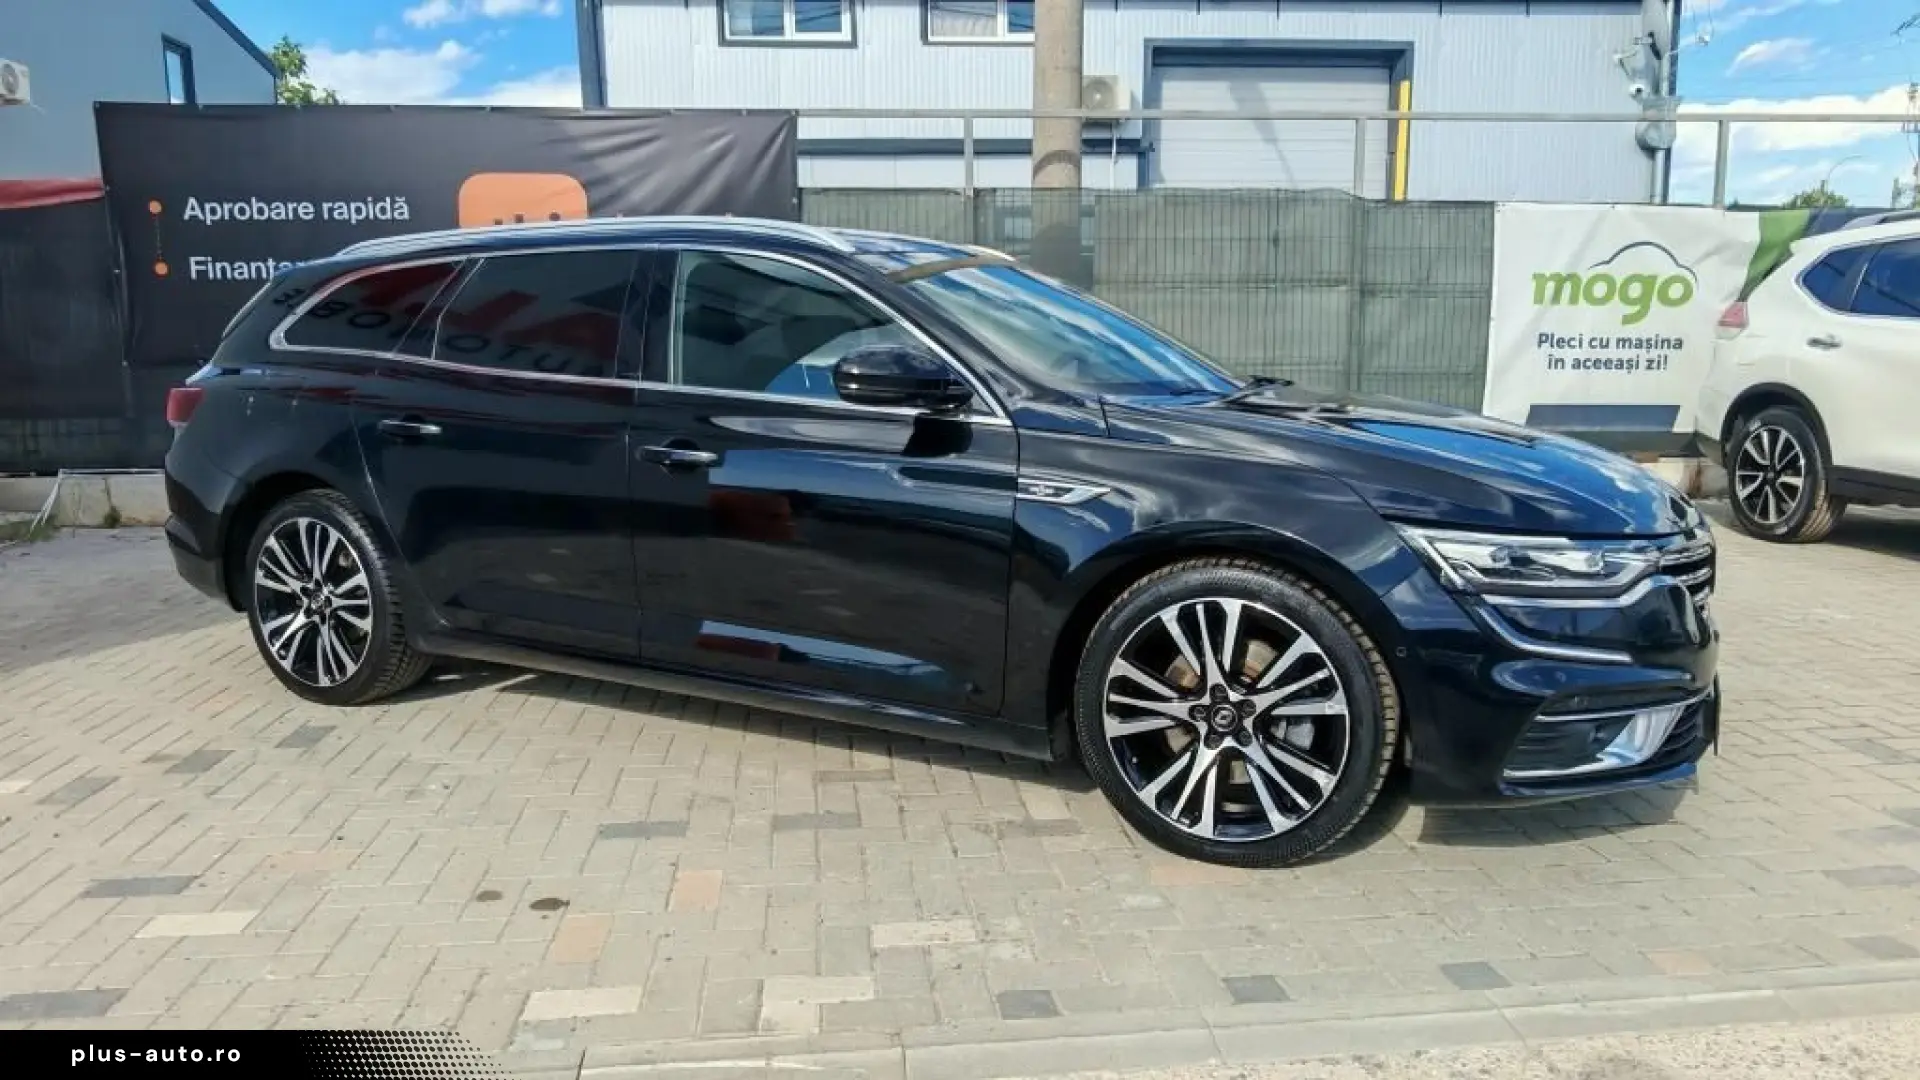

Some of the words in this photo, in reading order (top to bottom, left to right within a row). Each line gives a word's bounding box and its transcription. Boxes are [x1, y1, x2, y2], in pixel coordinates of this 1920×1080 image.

[183, 196, 316, 225] Aprobare
[322, 197, 411, 225] rapidă
[1532, 271, 1694, 326] mogo
[1537, 333, 1583, 350] Pleci
[1587, 338, 1610, 350] cu
[1615, 333, 1683, 353] mașina
[1547, 354, 1565, 370] în
[1570, 355, 1640, 374] aceeași
[1645, 355, 1668, 370] zi!
